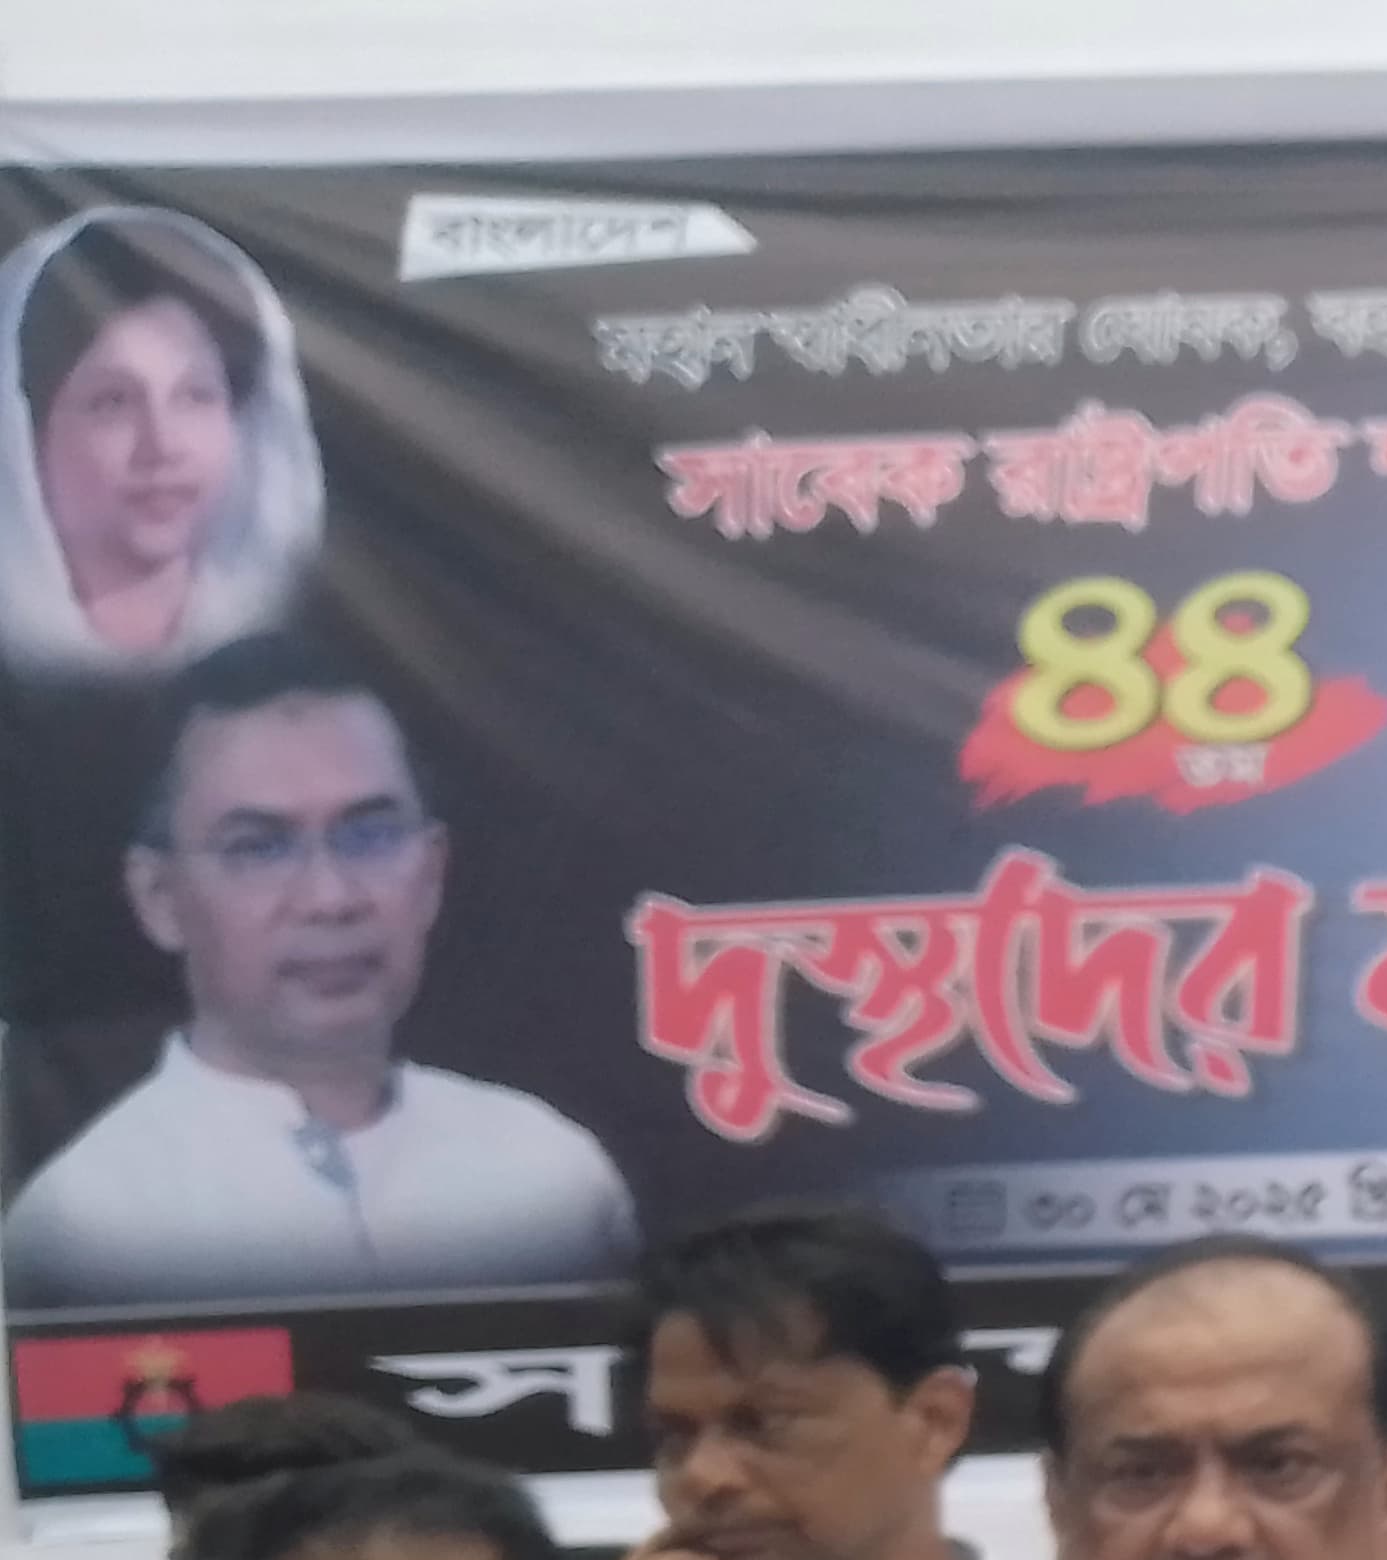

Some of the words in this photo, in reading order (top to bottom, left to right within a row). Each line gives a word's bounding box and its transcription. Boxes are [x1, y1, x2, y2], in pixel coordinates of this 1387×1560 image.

[428, 209, 690, 256] বাংলাদেশ
[658, 430, 978, 540] সাবেক
[982, 396, 1354, 534] রাষ্ট্রপতি
[1014, 574, 1312, 752] ৪৪
[628, 846, 1312, 1140] দুস্থদের
[1023, 1188, 1094, 1230] ৩০
[1112, 1183, 1174, 1226] মে
[1192, 1178, 1328, 1224] ২০২৫
